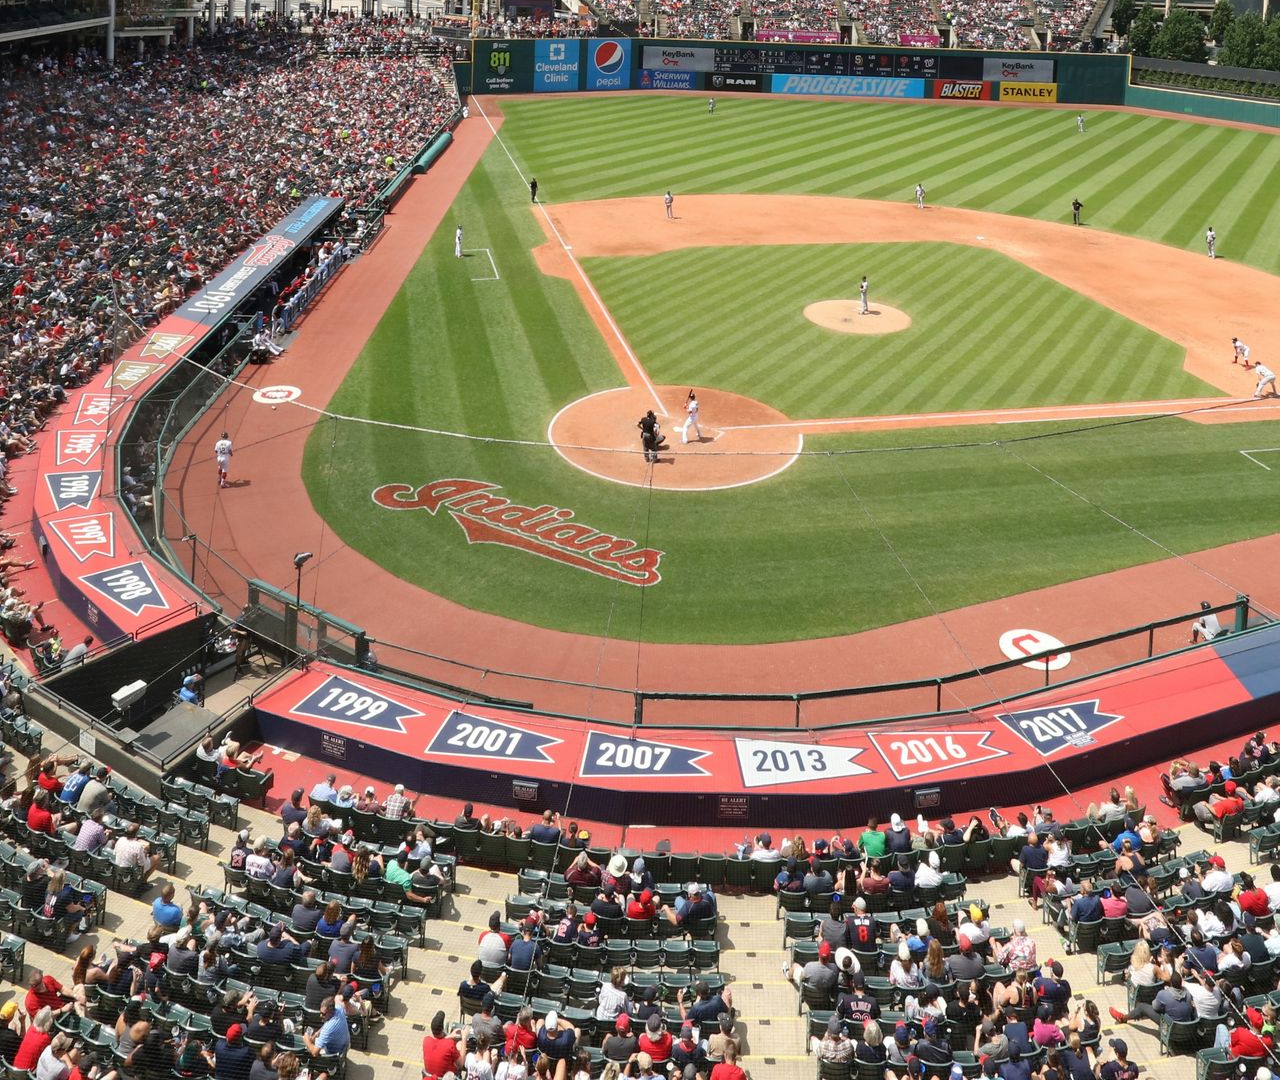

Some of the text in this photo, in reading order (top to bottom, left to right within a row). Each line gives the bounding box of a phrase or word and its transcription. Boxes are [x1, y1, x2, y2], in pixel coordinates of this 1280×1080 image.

[490, 52, 510, 67] 811
[662, 50, 695, 58] KeyBank
[535, 62, 578, 72] Cleveland
[654, 72, 690, 80] SHERWIN
[1002, 62, 1034, 70] KeyBank
[544, 74, 569, 83] Clinic
[596, 77, 621, 87] pepsi
[726, 78, 756, 86] RAM
[783, 76, 911, 96] PROGRESSIVE
[940, 83, 983, 98] BLASTER
[1003, 87, 1053, 97] STANLEY
[188, 290, 237, 314] 1901
[64, 433, 97, 454] 1995
[59, 474, 90, 500] 1996
[69, 519, 106, 545] 1997
[372, 478, 665, 586] Indians
[102, 568, 153, 601] 1998
[317, 686, 390, 722] 1999
[1020, 707, 1088, 742] 2017
[447, 722, 522, 757] 2001
[596, 742, 672, 771] 2007
[752, 749, 827, 773] 2013
[890, 735, 968, 766] 2016
